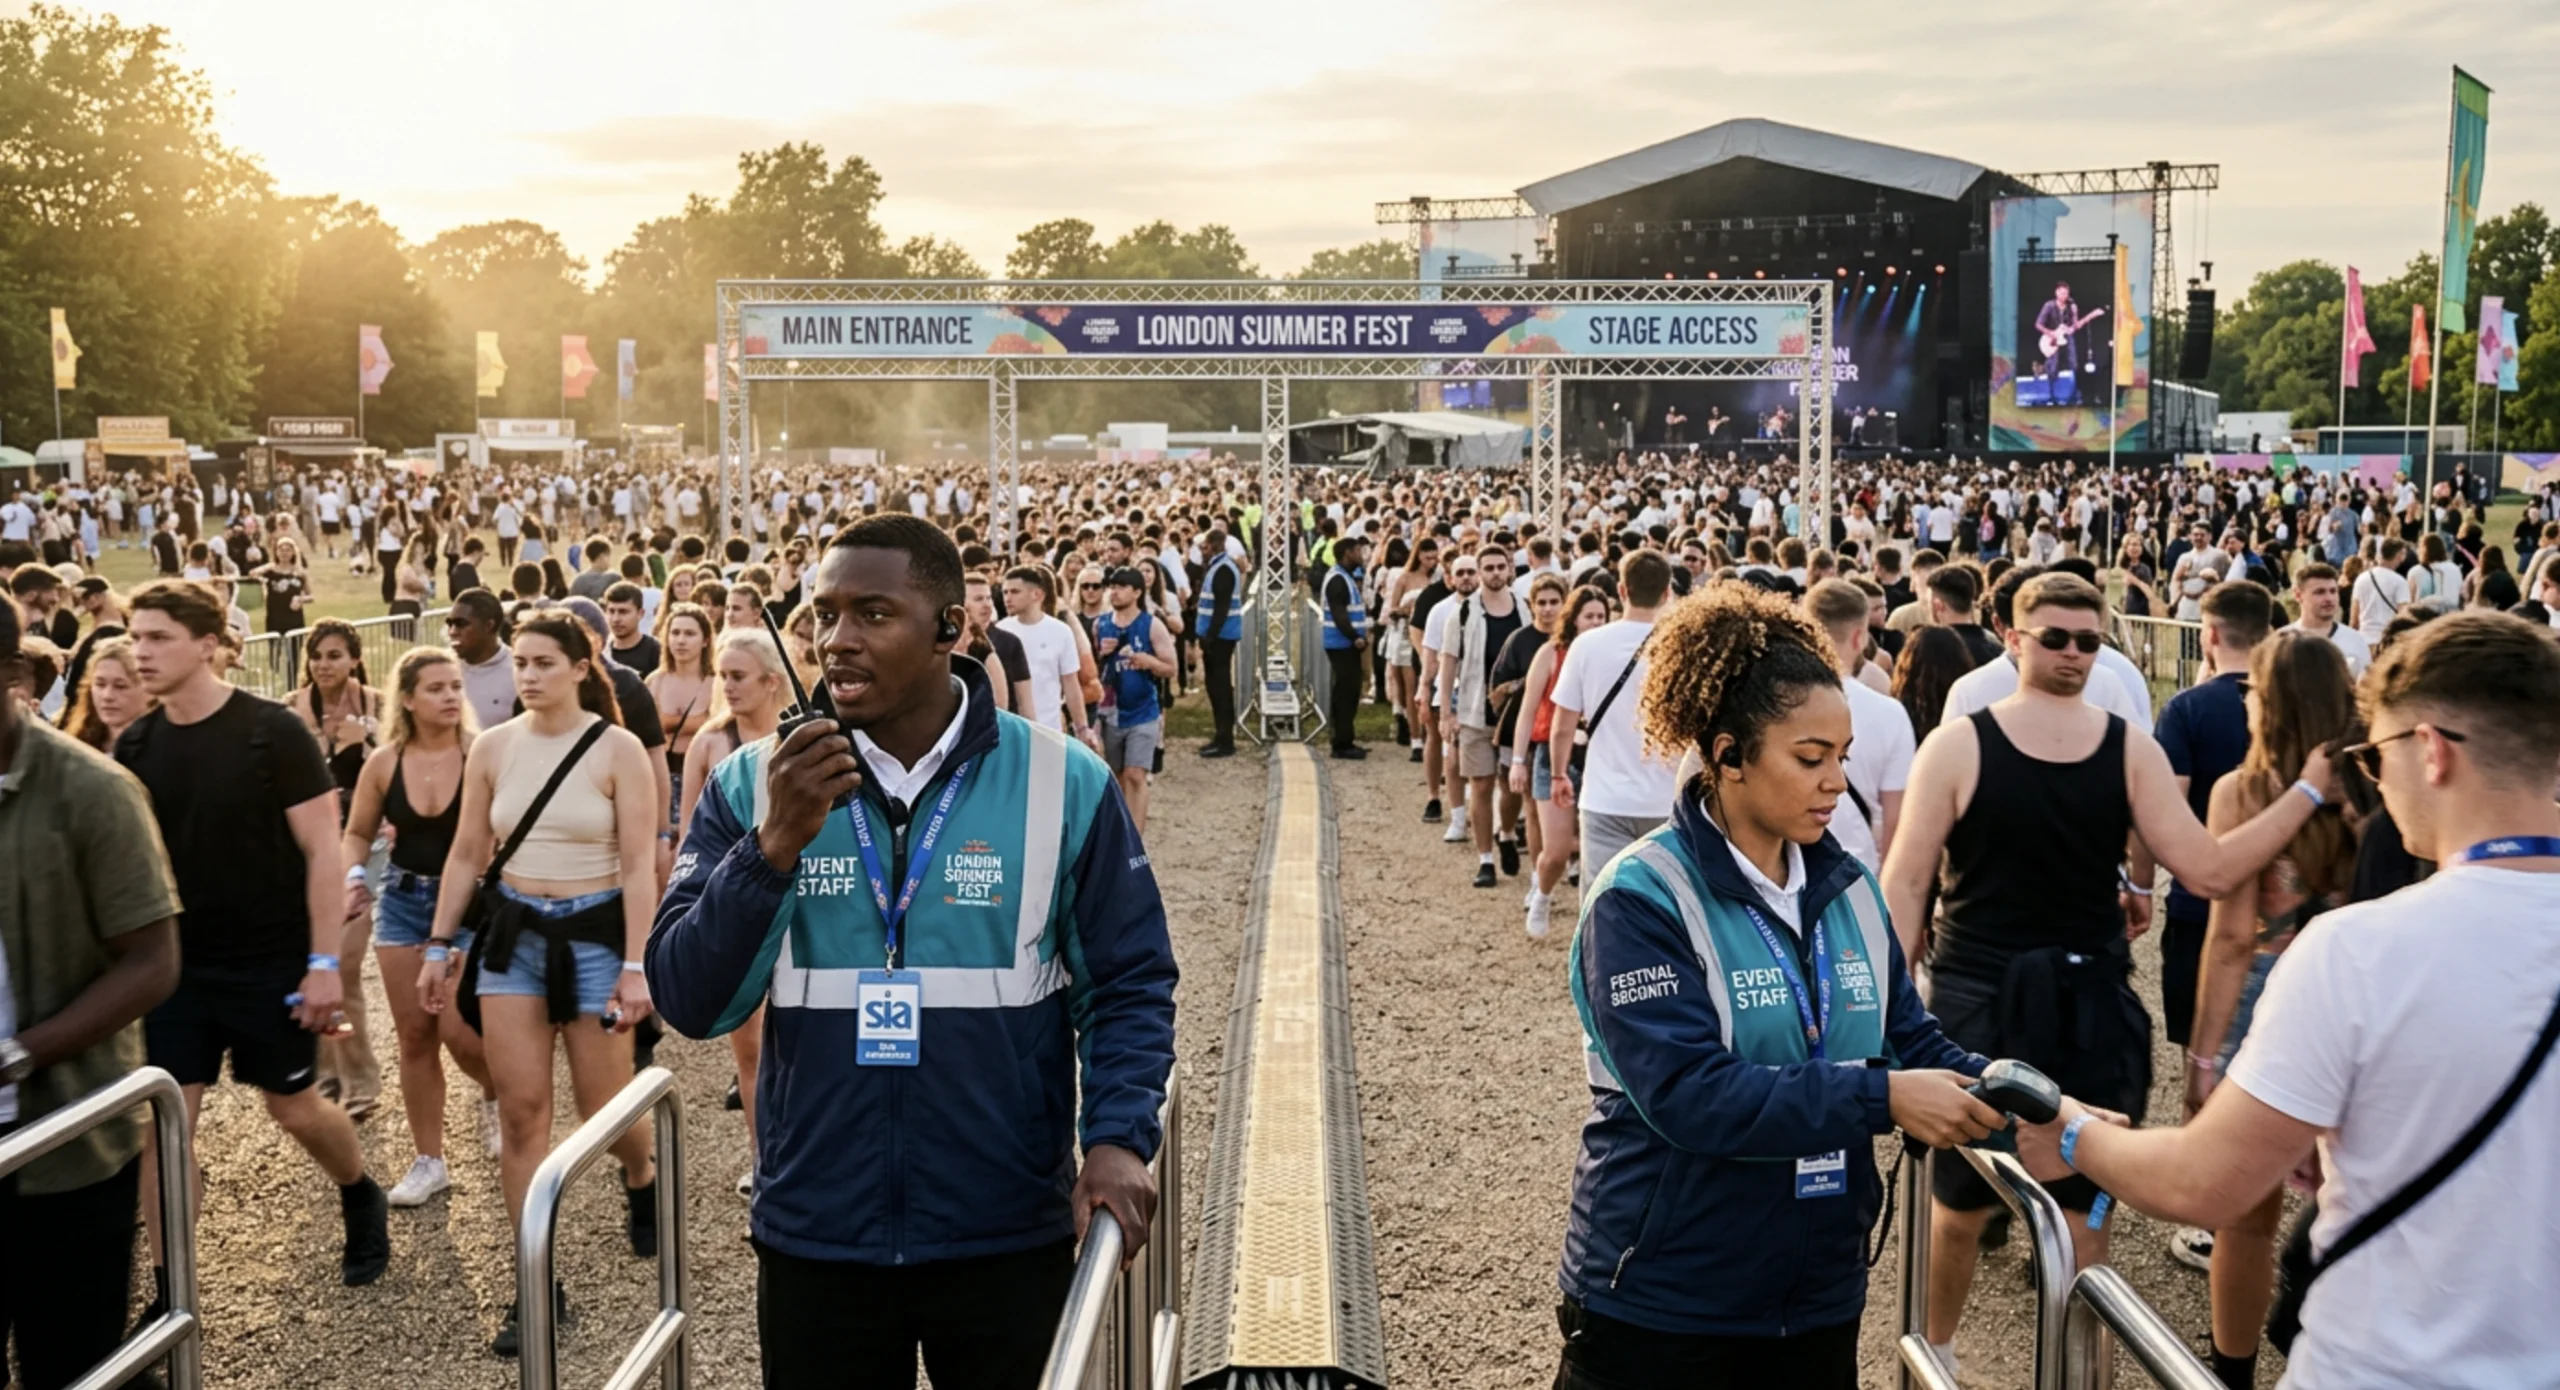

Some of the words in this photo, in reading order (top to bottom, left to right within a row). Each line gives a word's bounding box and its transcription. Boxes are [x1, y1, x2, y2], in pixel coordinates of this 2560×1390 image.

[783, 316, 842, 344] MAIN
[850, 316, 972, 344] ENTRANCE
[1138, 315, 1234, 345] LONDON
[1240, 315, 1347, 345] SUMMER
[1354, 315, 1413, 345] FEST
[1589, 316, 1661, 344] STAGE
[1668, 316, 1758, 344] ACCESS
[797, 877, 855, 896] STAFF
[1731, 967, 1784, 988] EVENT
[865, 989, 911, 1029] sia
[1736, 987, 1788, 1009] STAFF
